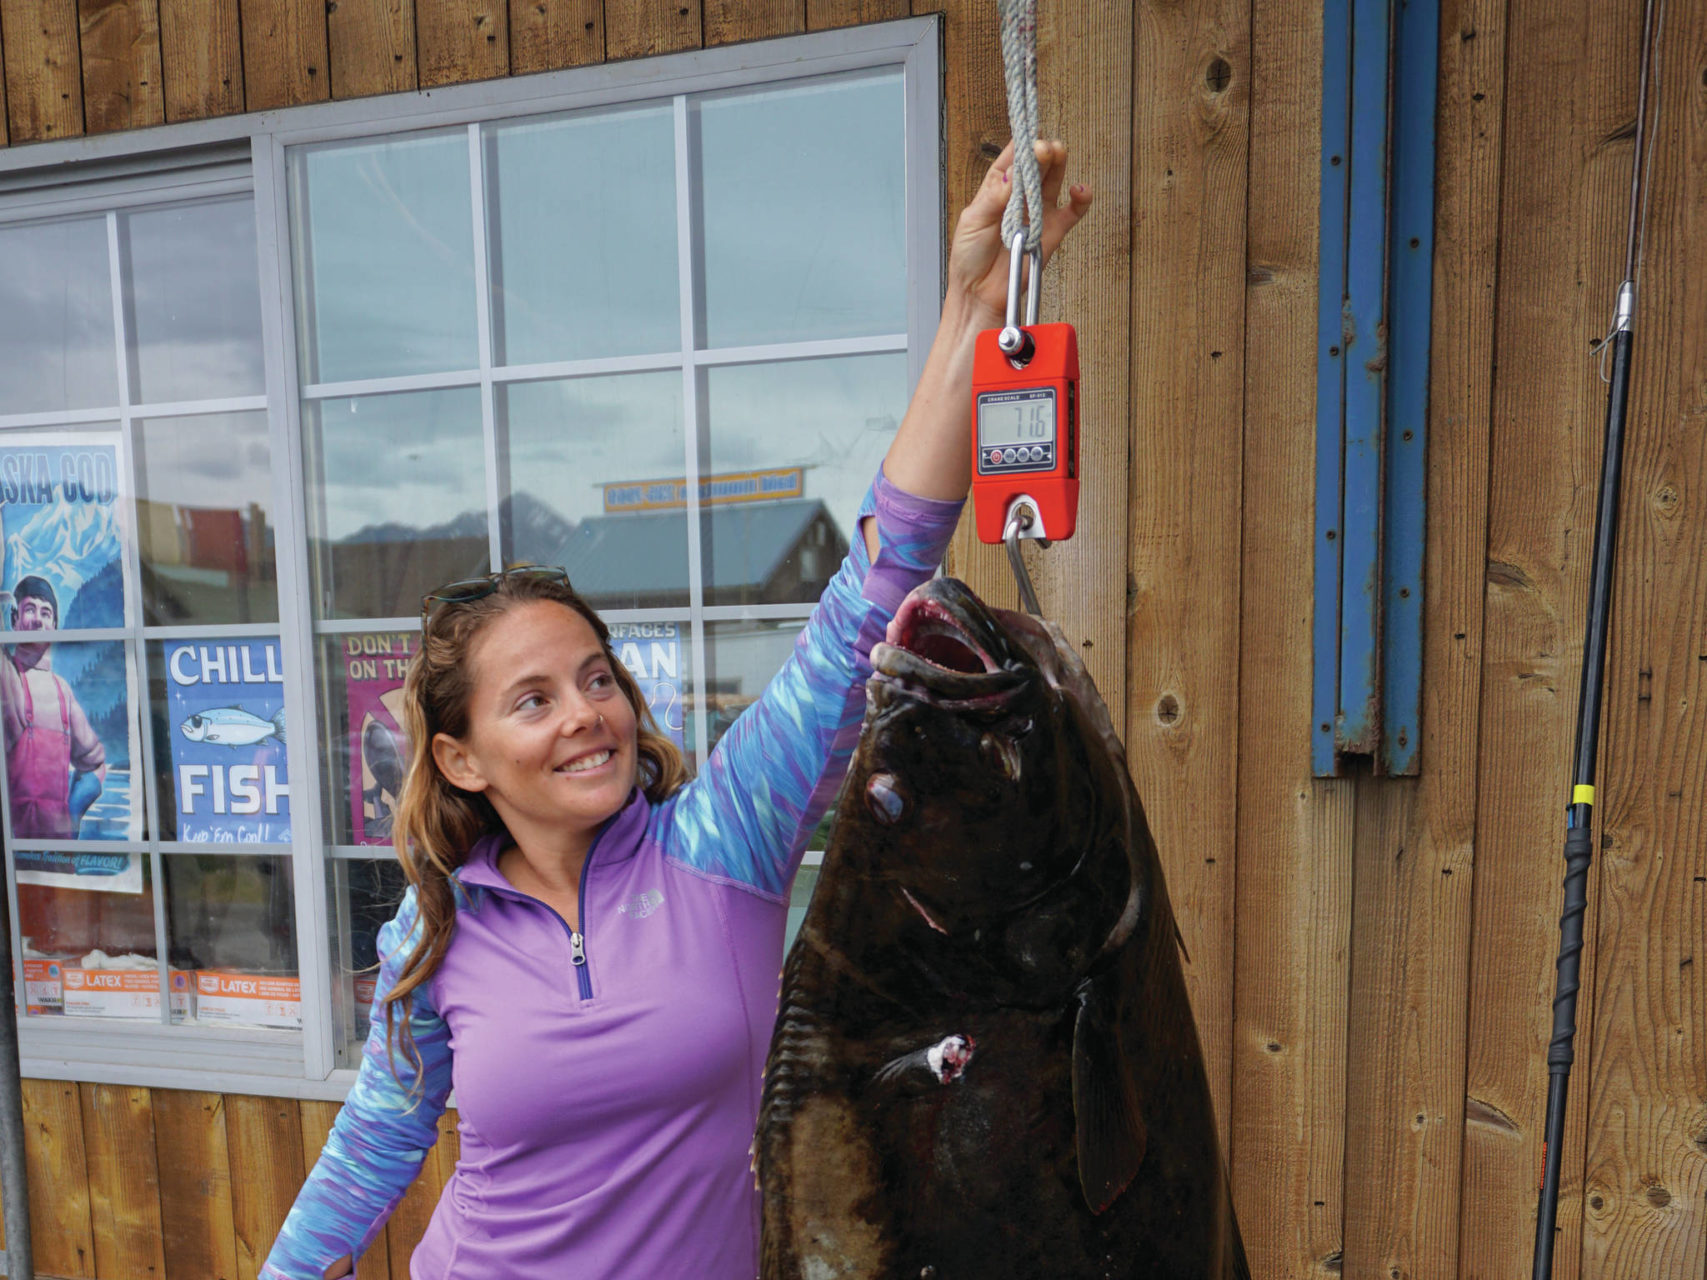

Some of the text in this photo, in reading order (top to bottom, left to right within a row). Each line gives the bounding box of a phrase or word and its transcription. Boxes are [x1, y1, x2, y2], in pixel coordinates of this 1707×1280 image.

[60, 452, 113, 505] COD
[347, 633, 411, 656] DON'T
[169, 644, 284, 687] CHILL
[349, 659, 378, 681] ON
[178, 763, 291, 815] FISH
[80, 853, 123, 870] FLAVOR!
[86, 974, 122, 988] LATEX
[220, 979, 257, 995] LATEX
